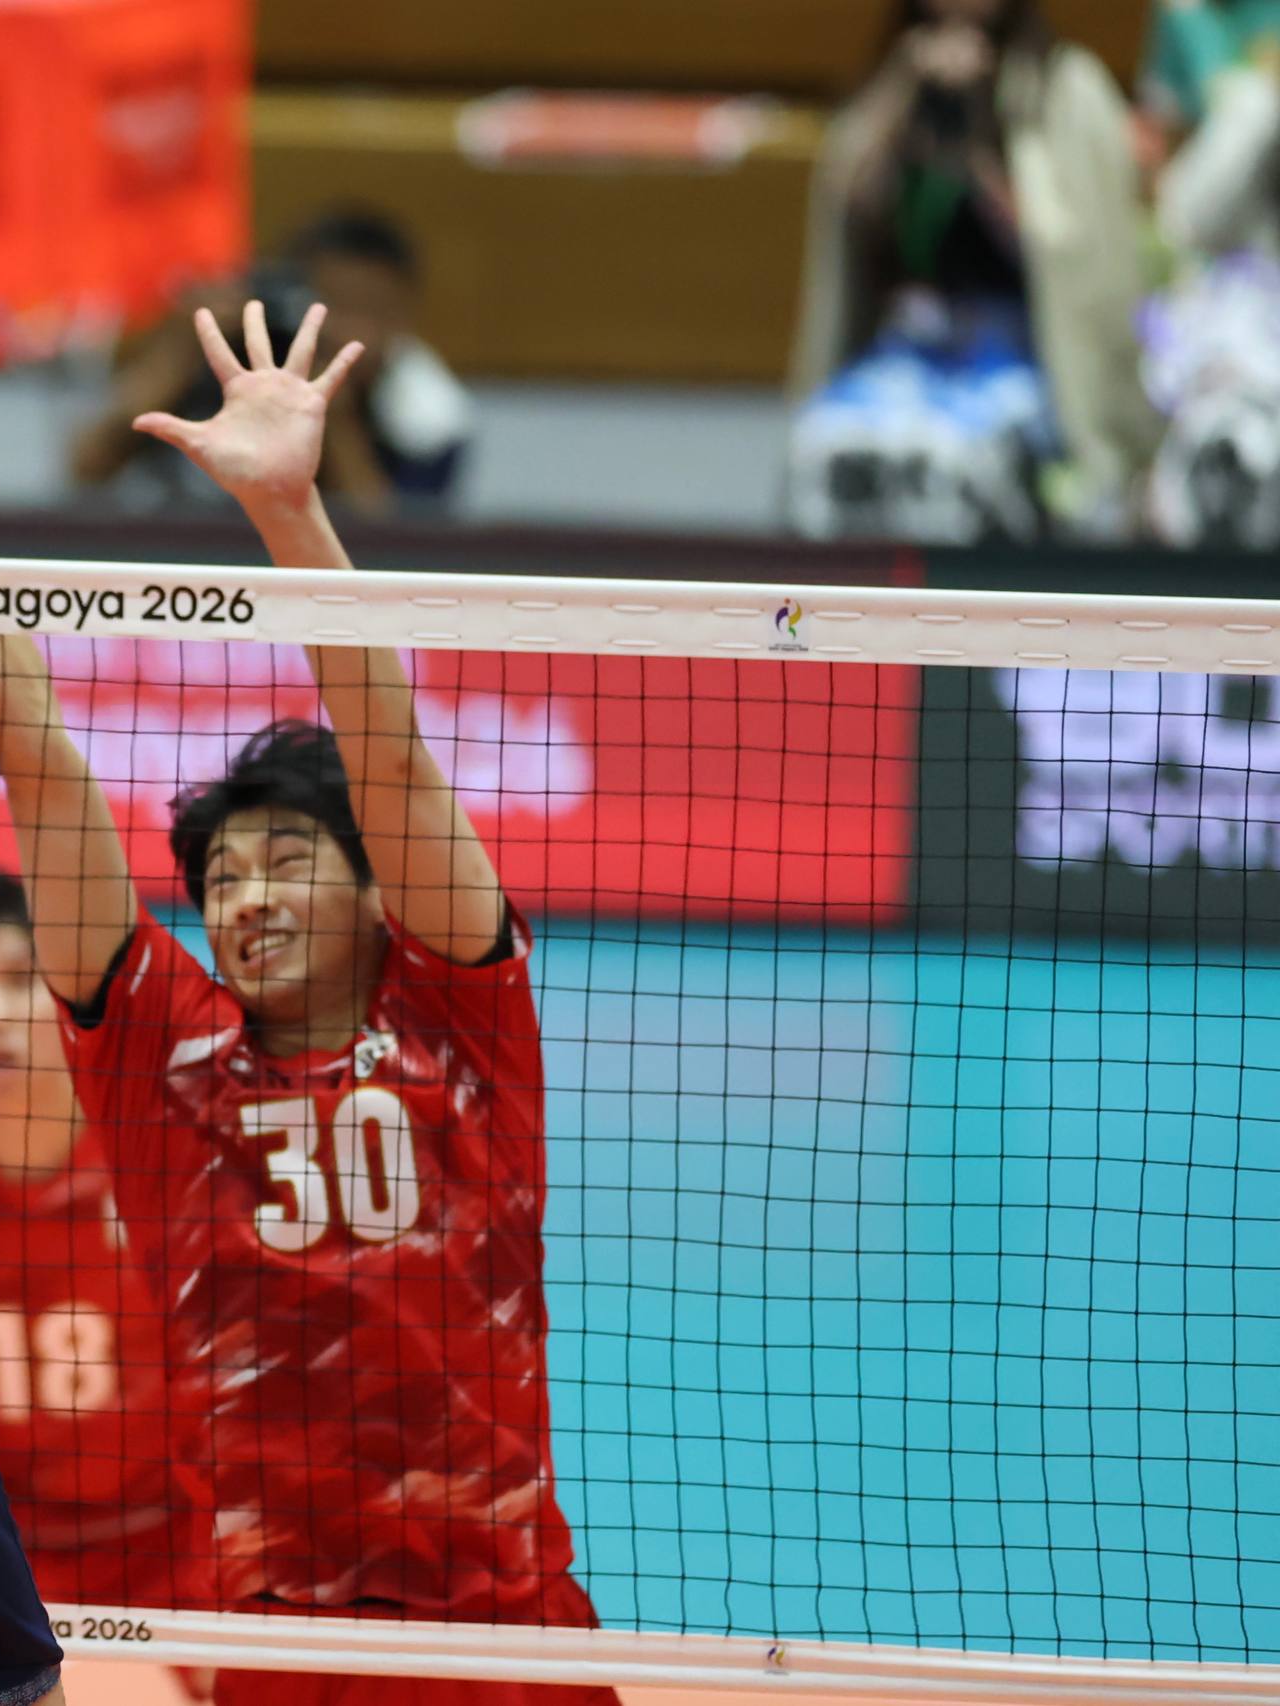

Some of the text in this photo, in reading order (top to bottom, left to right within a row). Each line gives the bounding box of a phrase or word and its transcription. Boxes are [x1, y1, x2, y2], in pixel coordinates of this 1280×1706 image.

[140, 584, 255, 624] 2026
[240, 1086, 420, 1250] 30
[81, 1618, 153, 1642] 2026
